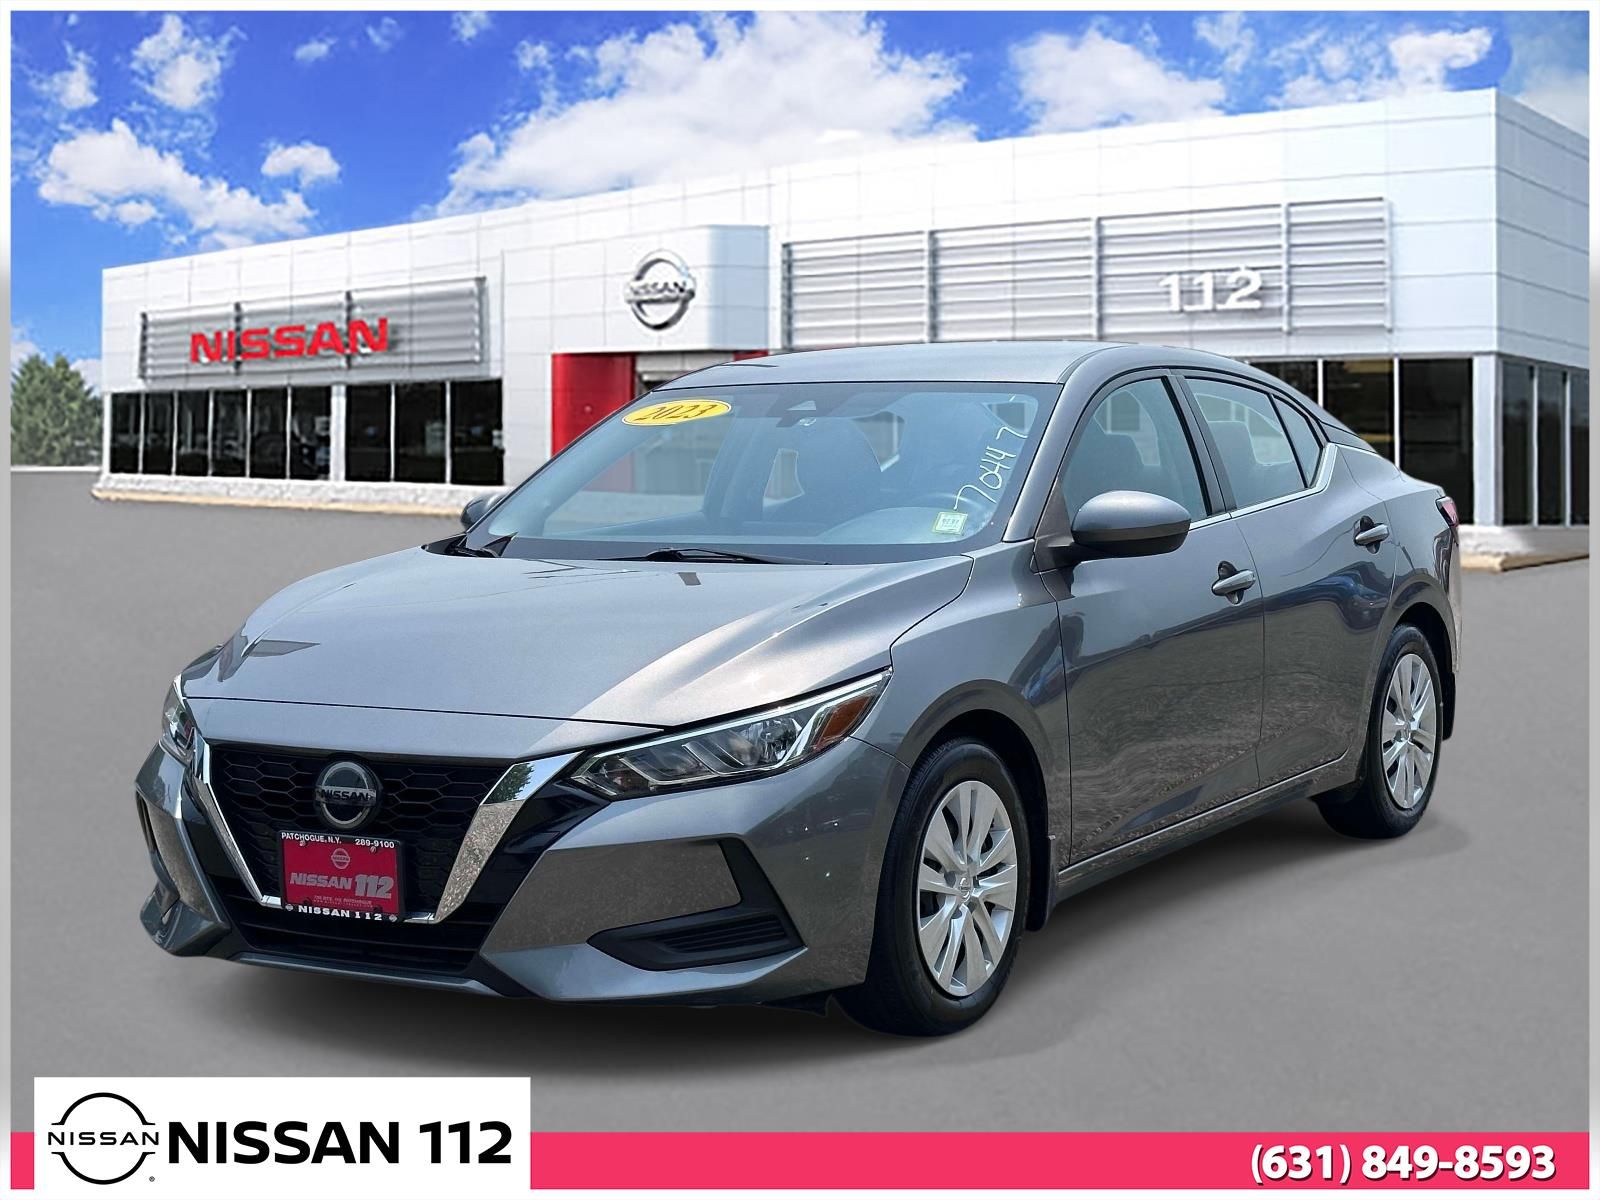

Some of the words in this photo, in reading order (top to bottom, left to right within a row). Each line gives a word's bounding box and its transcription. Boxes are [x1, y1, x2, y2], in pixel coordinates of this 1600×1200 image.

[1159, 265, 1263, 312] 112
[190, 317, 389, 363] NISSAN
[634, 404, 718, 421] 2023
[321, 789, 369, 801] NISSAN
[355, 838, 395, 849] 289-9100
[290, 872, 352, 889] NISSAN
[355, 874, 394, 898] 112
[298, 905, 350, 918] NISSAN
